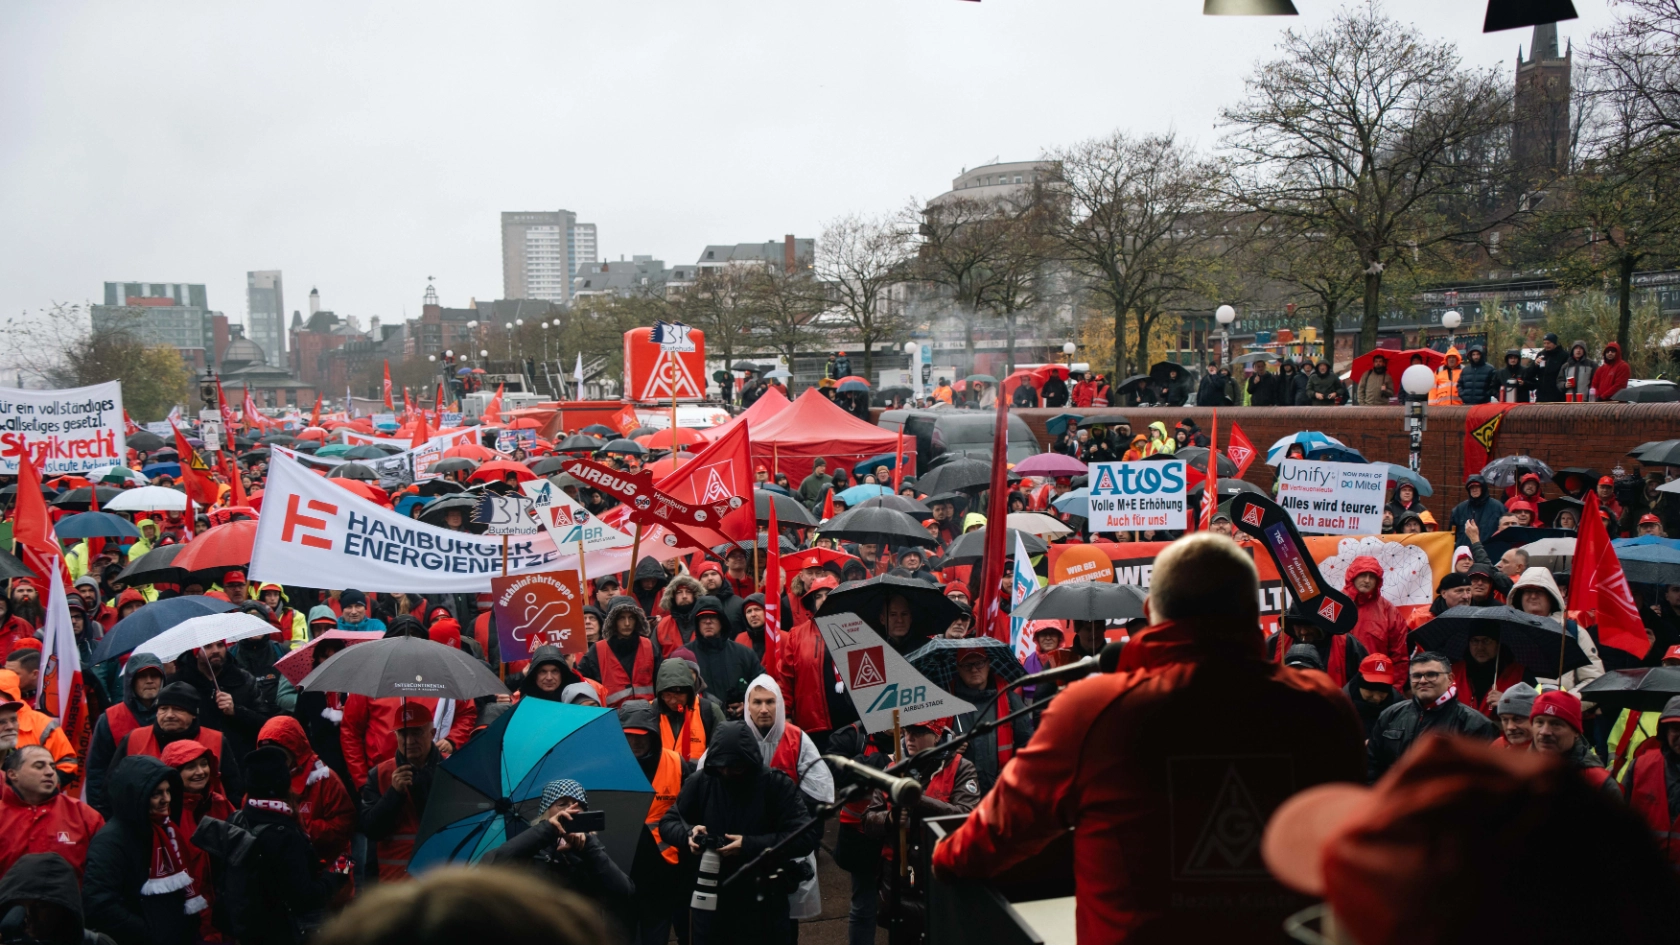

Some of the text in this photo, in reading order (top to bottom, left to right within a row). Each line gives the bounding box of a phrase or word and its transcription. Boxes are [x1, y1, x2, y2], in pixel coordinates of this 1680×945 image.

[0, 399, 115, 415] ür ein vollständiges
[63, 415, 107, 433] gesetzl.
[1, 429, 119, 459] Streikrecht
[567, 462, 638, 496] AIRBUS
[1282, 464, 1331, 487] Unify
[1354, 480, 1382, 491] Mitel
[653, 491, 688, 513] Hamburg
[1091, 498, 1183, 512] Volle M+E Erhöhung
[1281, 496, 1379, 515] Alles wird teurer.
[1106, 513, 1168, 526] Auch für uns!
[1297, 512, 1360, 530] Ich auch !!!
[347, 510, 533, 556] HAMBURGER
[488, 526, 538, 535] Buxtehude
[584, 527, 603, 540] BR
[343, 532, 560, 574] ENERGIENETZE
[1066, 560, 1097, 575] WIR BEI
[499, 574, 575, 607] #ichbinFahrtreppe
[900, 685, 927, 706] BR
[903, 699, 944, 713] AIRBUS STADE
